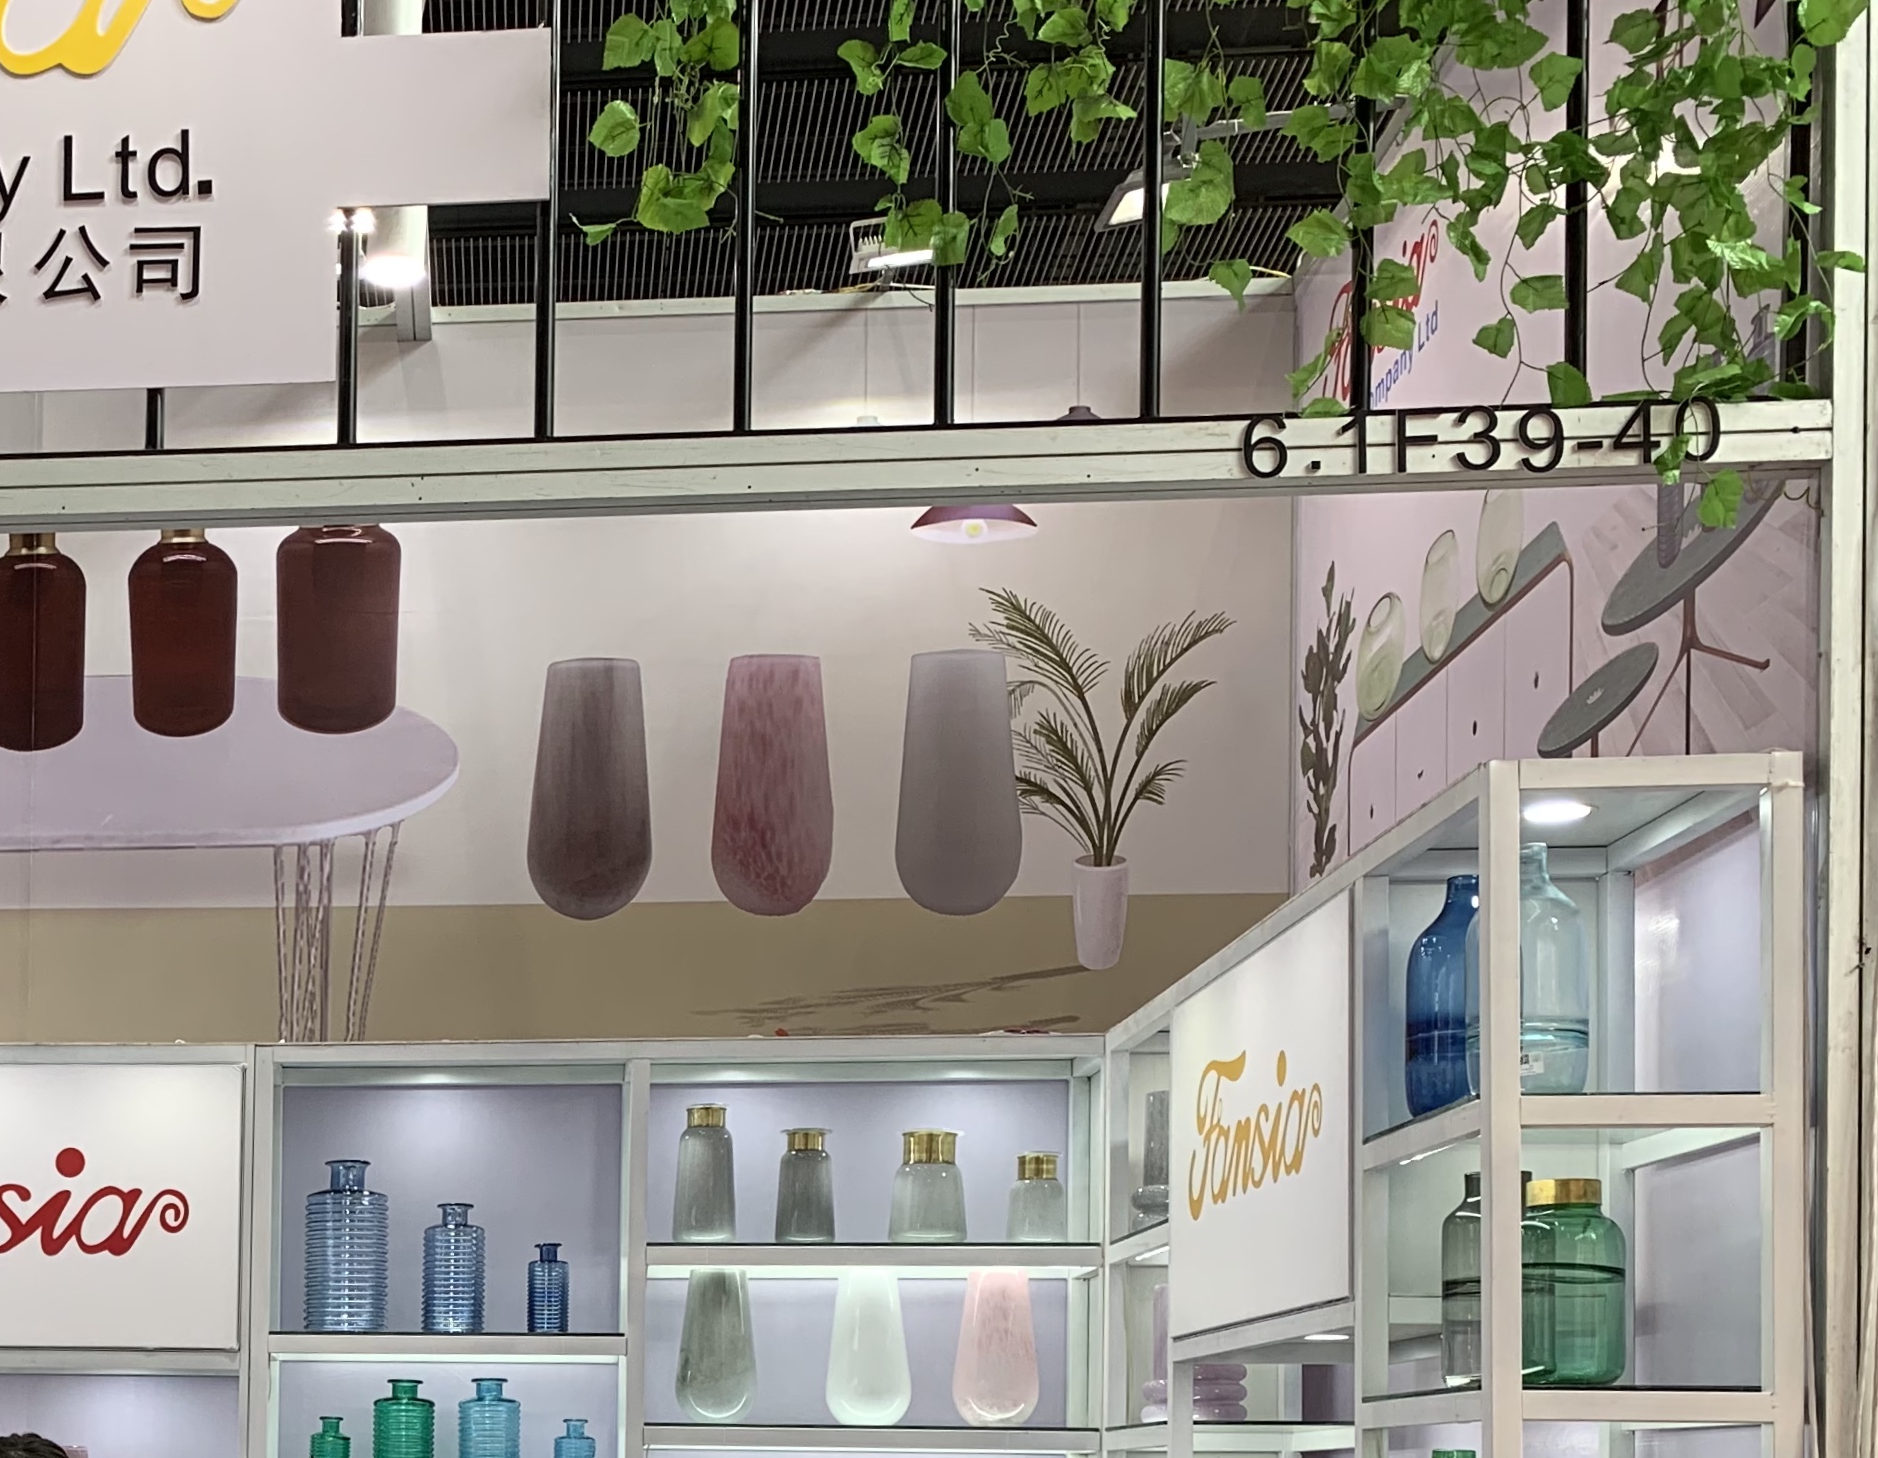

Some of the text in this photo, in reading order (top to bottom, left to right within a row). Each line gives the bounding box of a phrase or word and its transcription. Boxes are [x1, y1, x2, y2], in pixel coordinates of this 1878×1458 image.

[62, 128, 214, 202] Ltd.
[1370, 300, 1439, 408] ompany Ltd
[1242, 397, 1722, 479] 6.1F39-40
[1188, 1049, 1323, 1221] Fansia
